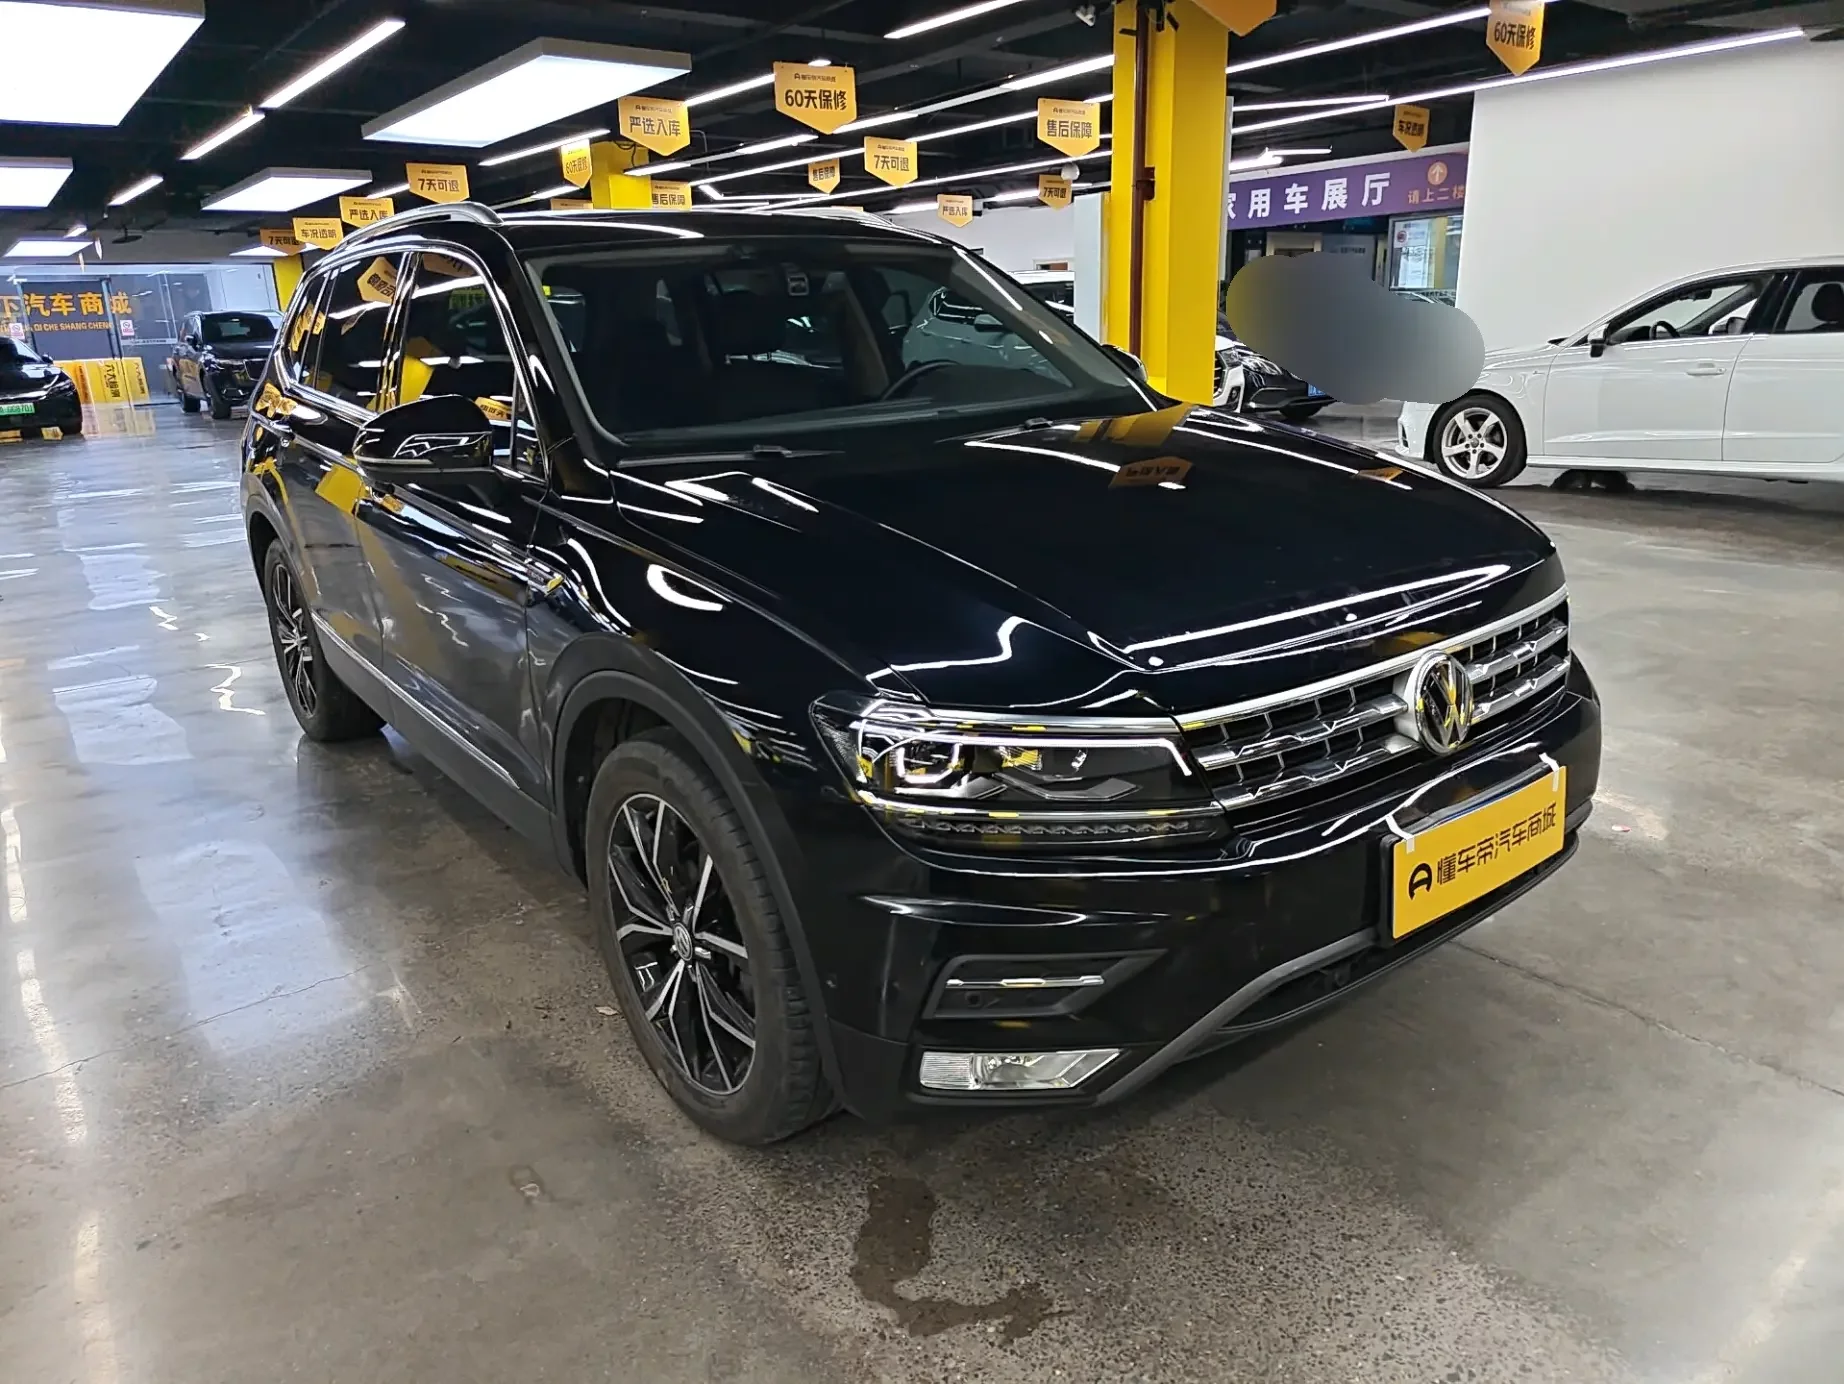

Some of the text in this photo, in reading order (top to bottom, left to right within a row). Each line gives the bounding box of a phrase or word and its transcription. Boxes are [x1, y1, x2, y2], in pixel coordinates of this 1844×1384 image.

[1494, 21, 1536, 50] 60天保修
[785, 88, 847, 110] 60天保修
[629, 115, 681, 137] 严选入库
[1046, 118, 1093, 139] 售后保障
[873, 154, 910, 172] 7天可退
[417, 178, 460, 192] 7天可退
[349, 208, 389, 221] 严选入库
[300, 228, 337, 239] 车况透明
[44, 323, 59, 332] CHE
[60, 321, 87, 331] SHANG
[1437, 801, 1557, 885] 懂车帝汽车商城
